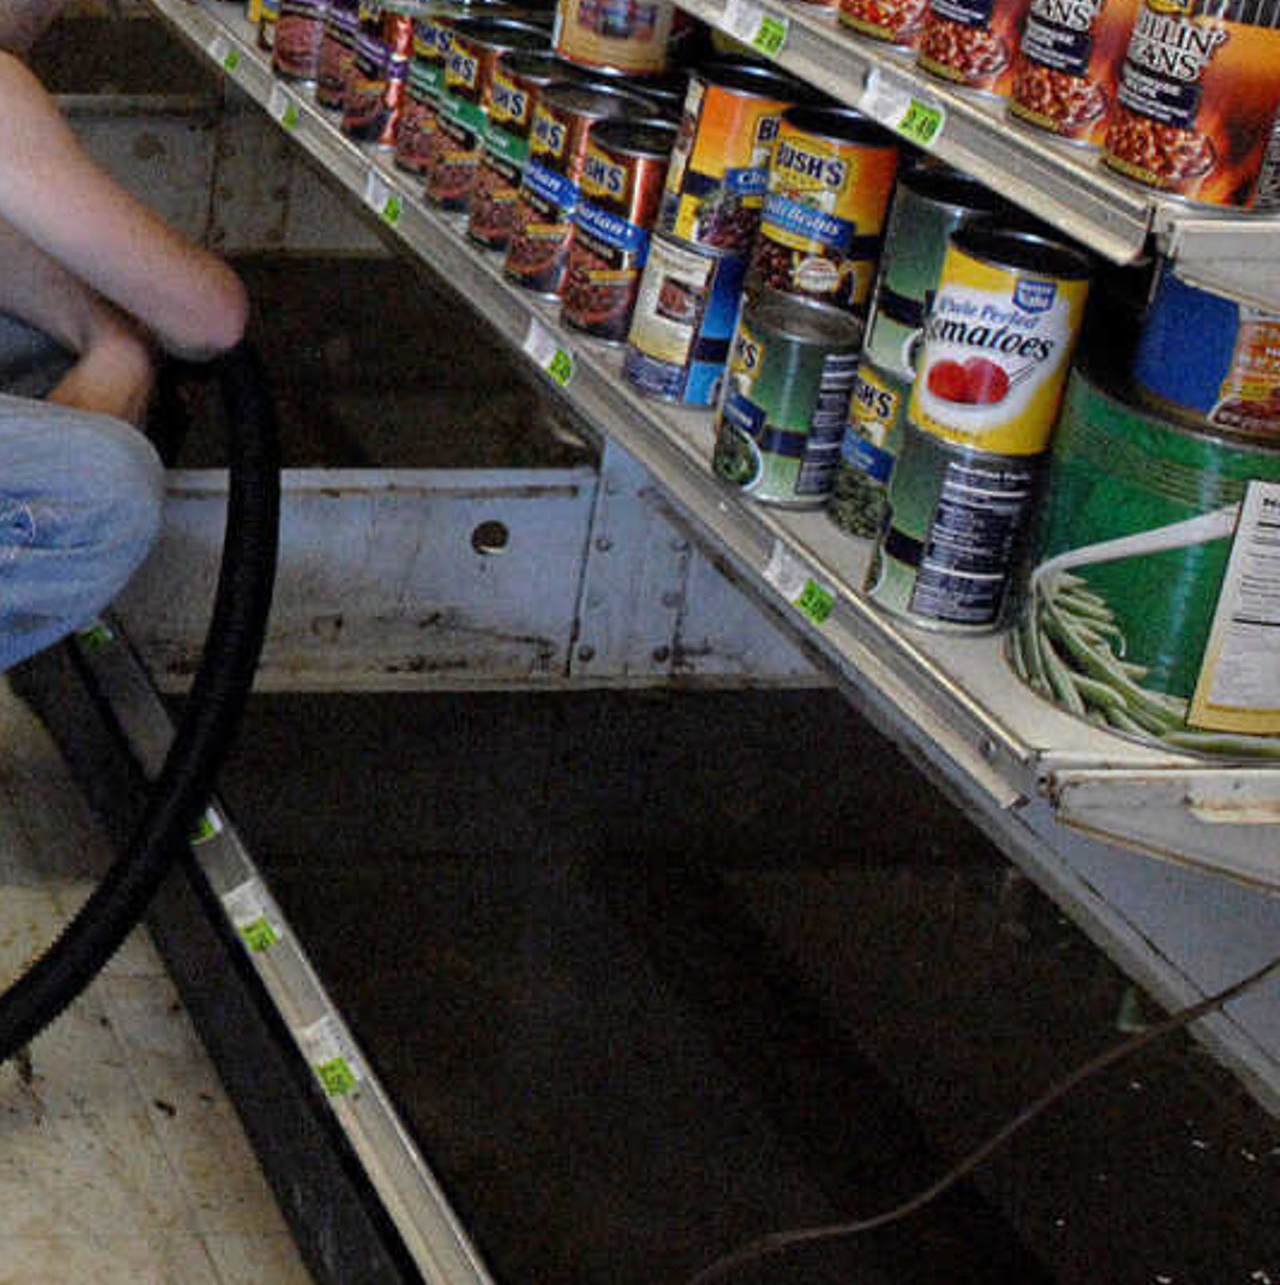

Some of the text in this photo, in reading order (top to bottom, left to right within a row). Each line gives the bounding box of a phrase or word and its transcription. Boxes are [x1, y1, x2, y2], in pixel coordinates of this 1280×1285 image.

[1140, 42, 1199, 81] ANS
[584, 155, 624, 192] SH'S
[932, 318, 1055, 363] matoes
[856, 382, 893, 418] SH'S
